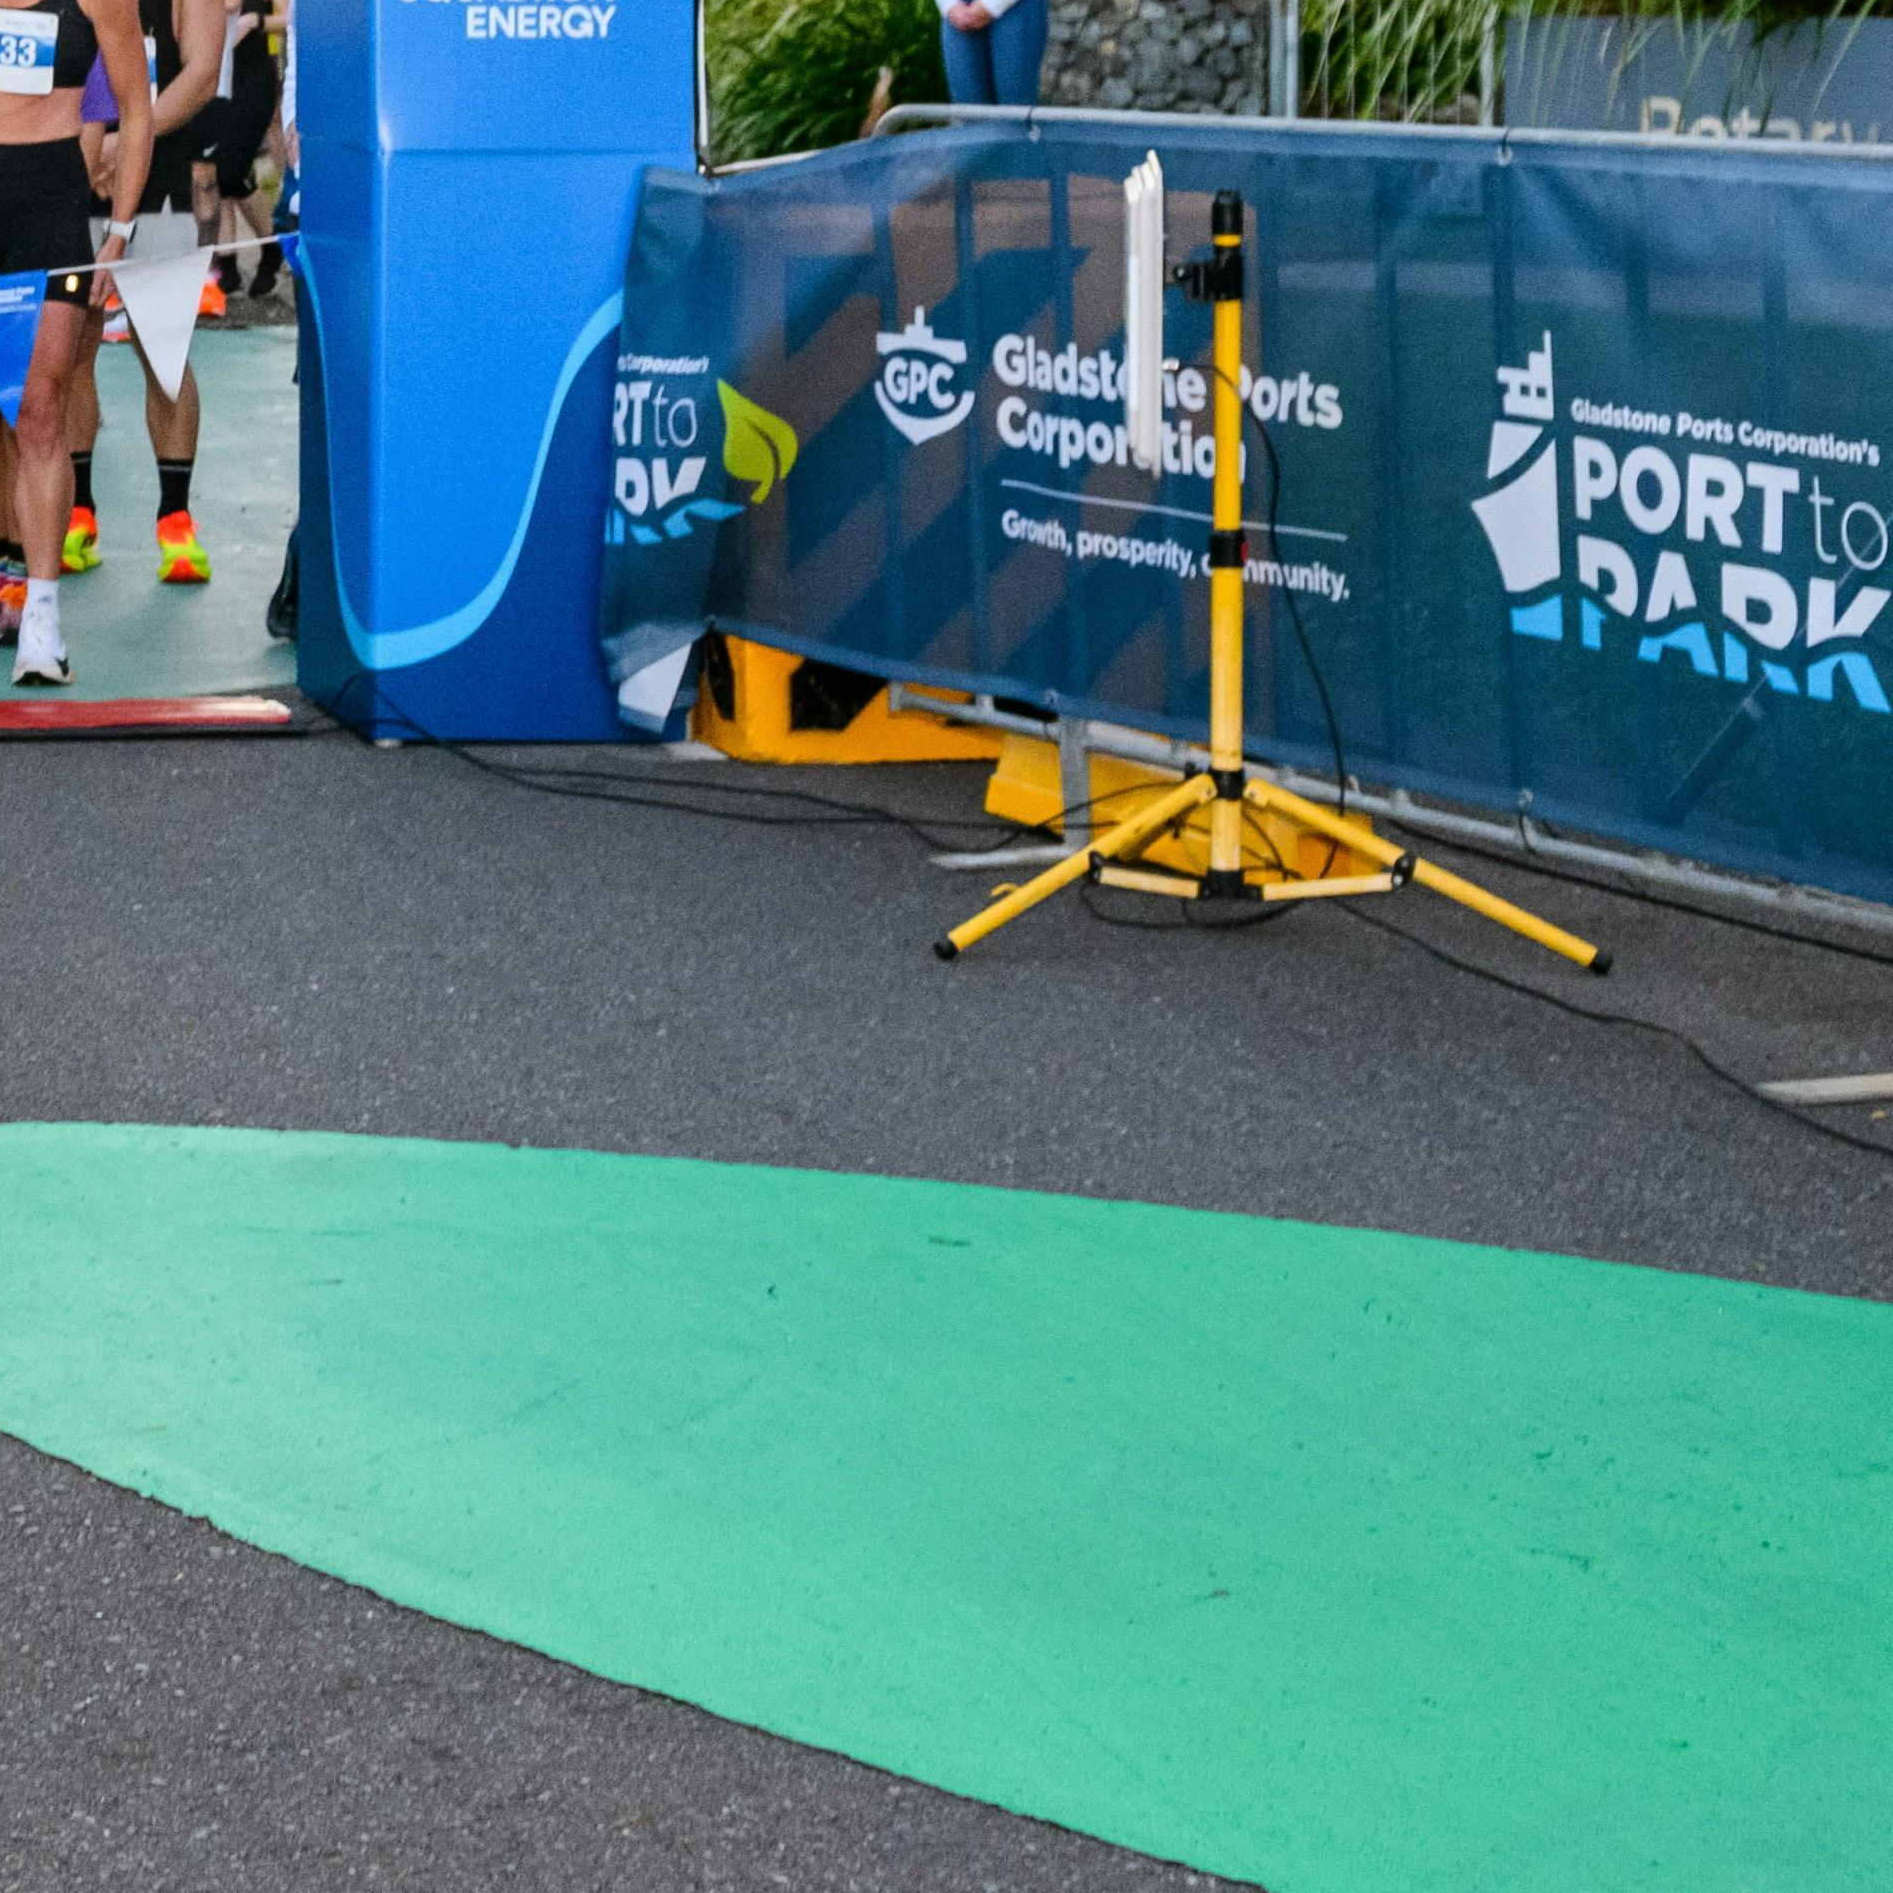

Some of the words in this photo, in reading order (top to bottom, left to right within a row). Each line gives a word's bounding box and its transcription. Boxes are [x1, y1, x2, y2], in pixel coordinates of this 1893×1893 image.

[466, 4, 616, 40] ENERGY
[612, 379, 653, 447] RT
[883, 355, 956, 411] GPC
[992, 333, 1208, 413] Gladste
[996, 395, 1246, 485] Corportio
[1570, 396, 1671, 437] Gladstone
[1675, 410, 1734, 446] Ports
[1737, 420, 1881, 468] Corporation's
[1572, 434, 1801, 555] PORT
[1808, 474, 1889, 571] to
[1001, 509, 1073, 556] Growth,
[1076, 530, 1197, 580] prosperity,
[1201, 552, 1351, 603] cmmunity.
[1576, 534, 1893, 714] PARK
